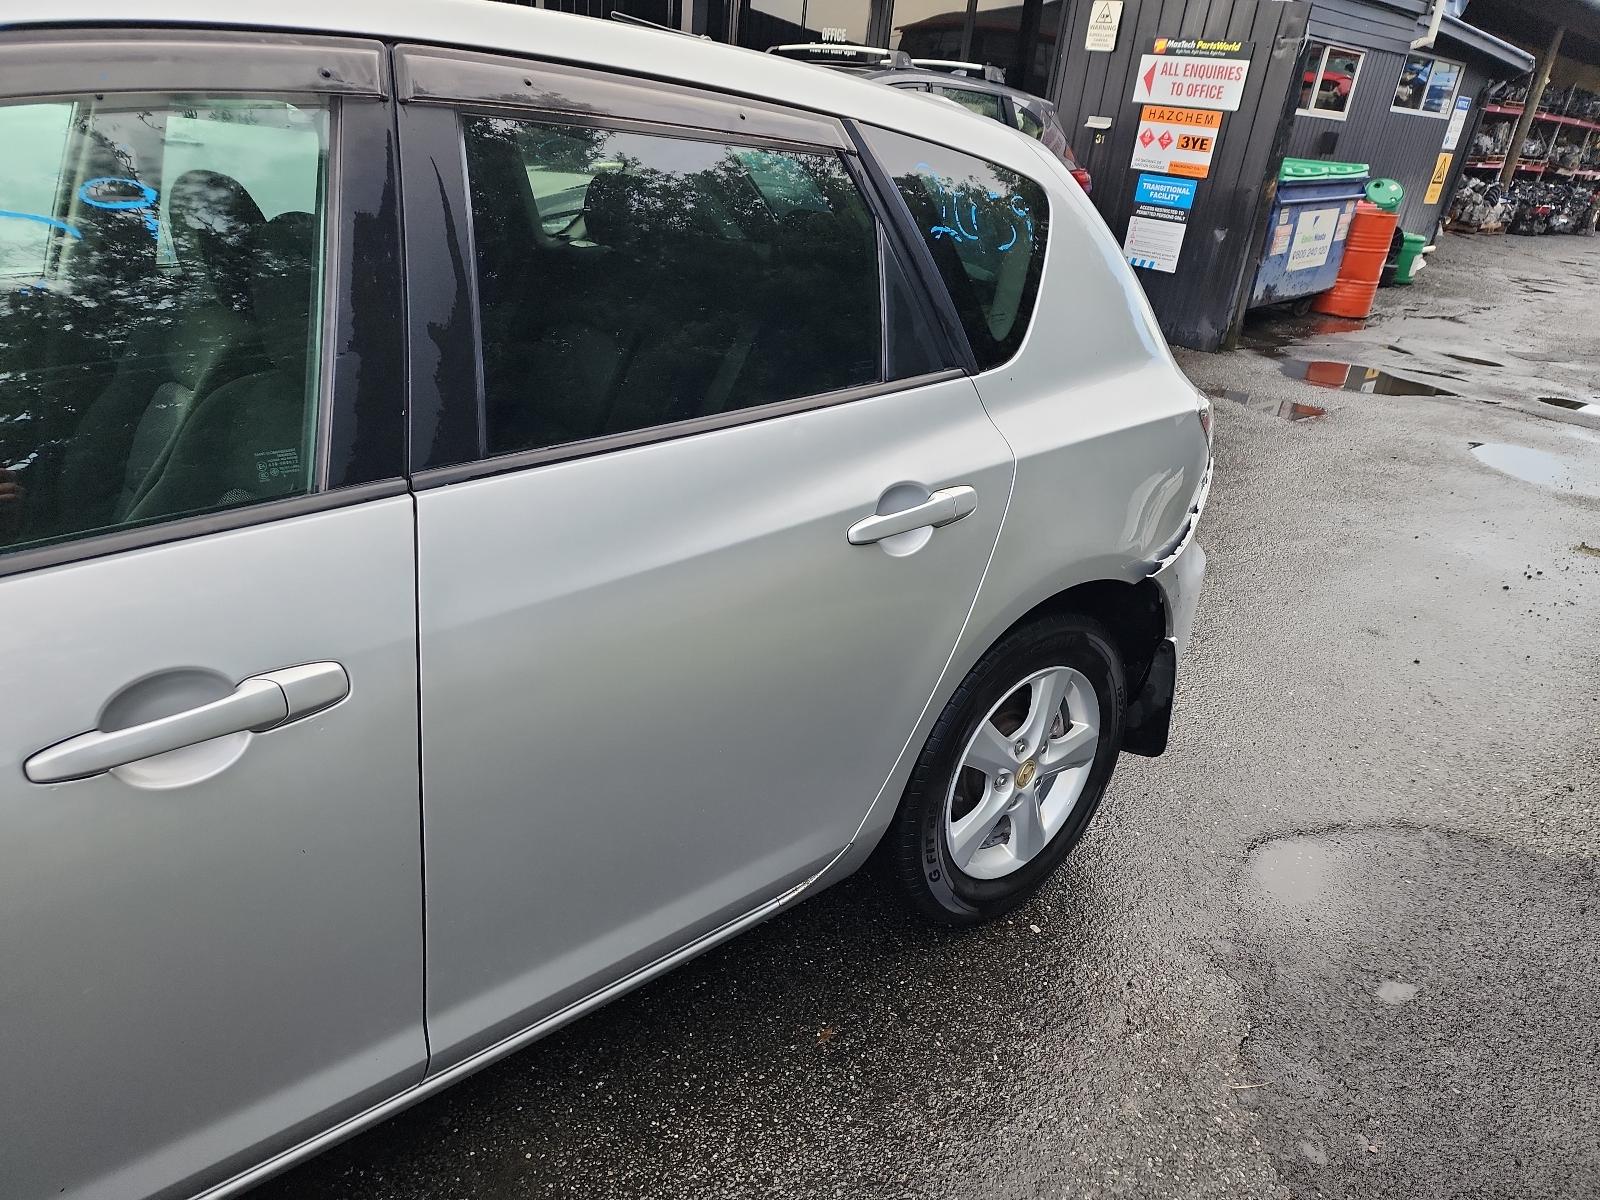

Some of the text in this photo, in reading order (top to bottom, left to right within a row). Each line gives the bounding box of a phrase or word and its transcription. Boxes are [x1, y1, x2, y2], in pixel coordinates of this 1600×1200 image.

[821, 27, 847, 42] OFFICE
[1090, 24, 1117, 32] WARNING
[1166, 39, 1242, 52] MaxTech PartsWorld
[1160, 61, 1244, 81] ALL ENQUIRIES
[1170, 81, 1225, 99] TO OFFICE
[1148, 108, 1214, 125] HAZCHEM
[1095, 133, 1105, 144] 31
[1181, 136, 1209, 150] 3YE
[1143, 182, 1190, 195] TRANSITIONAL
[1149, 191, 1180, 201] FACILITY
[928, 868, 941, 883] G
